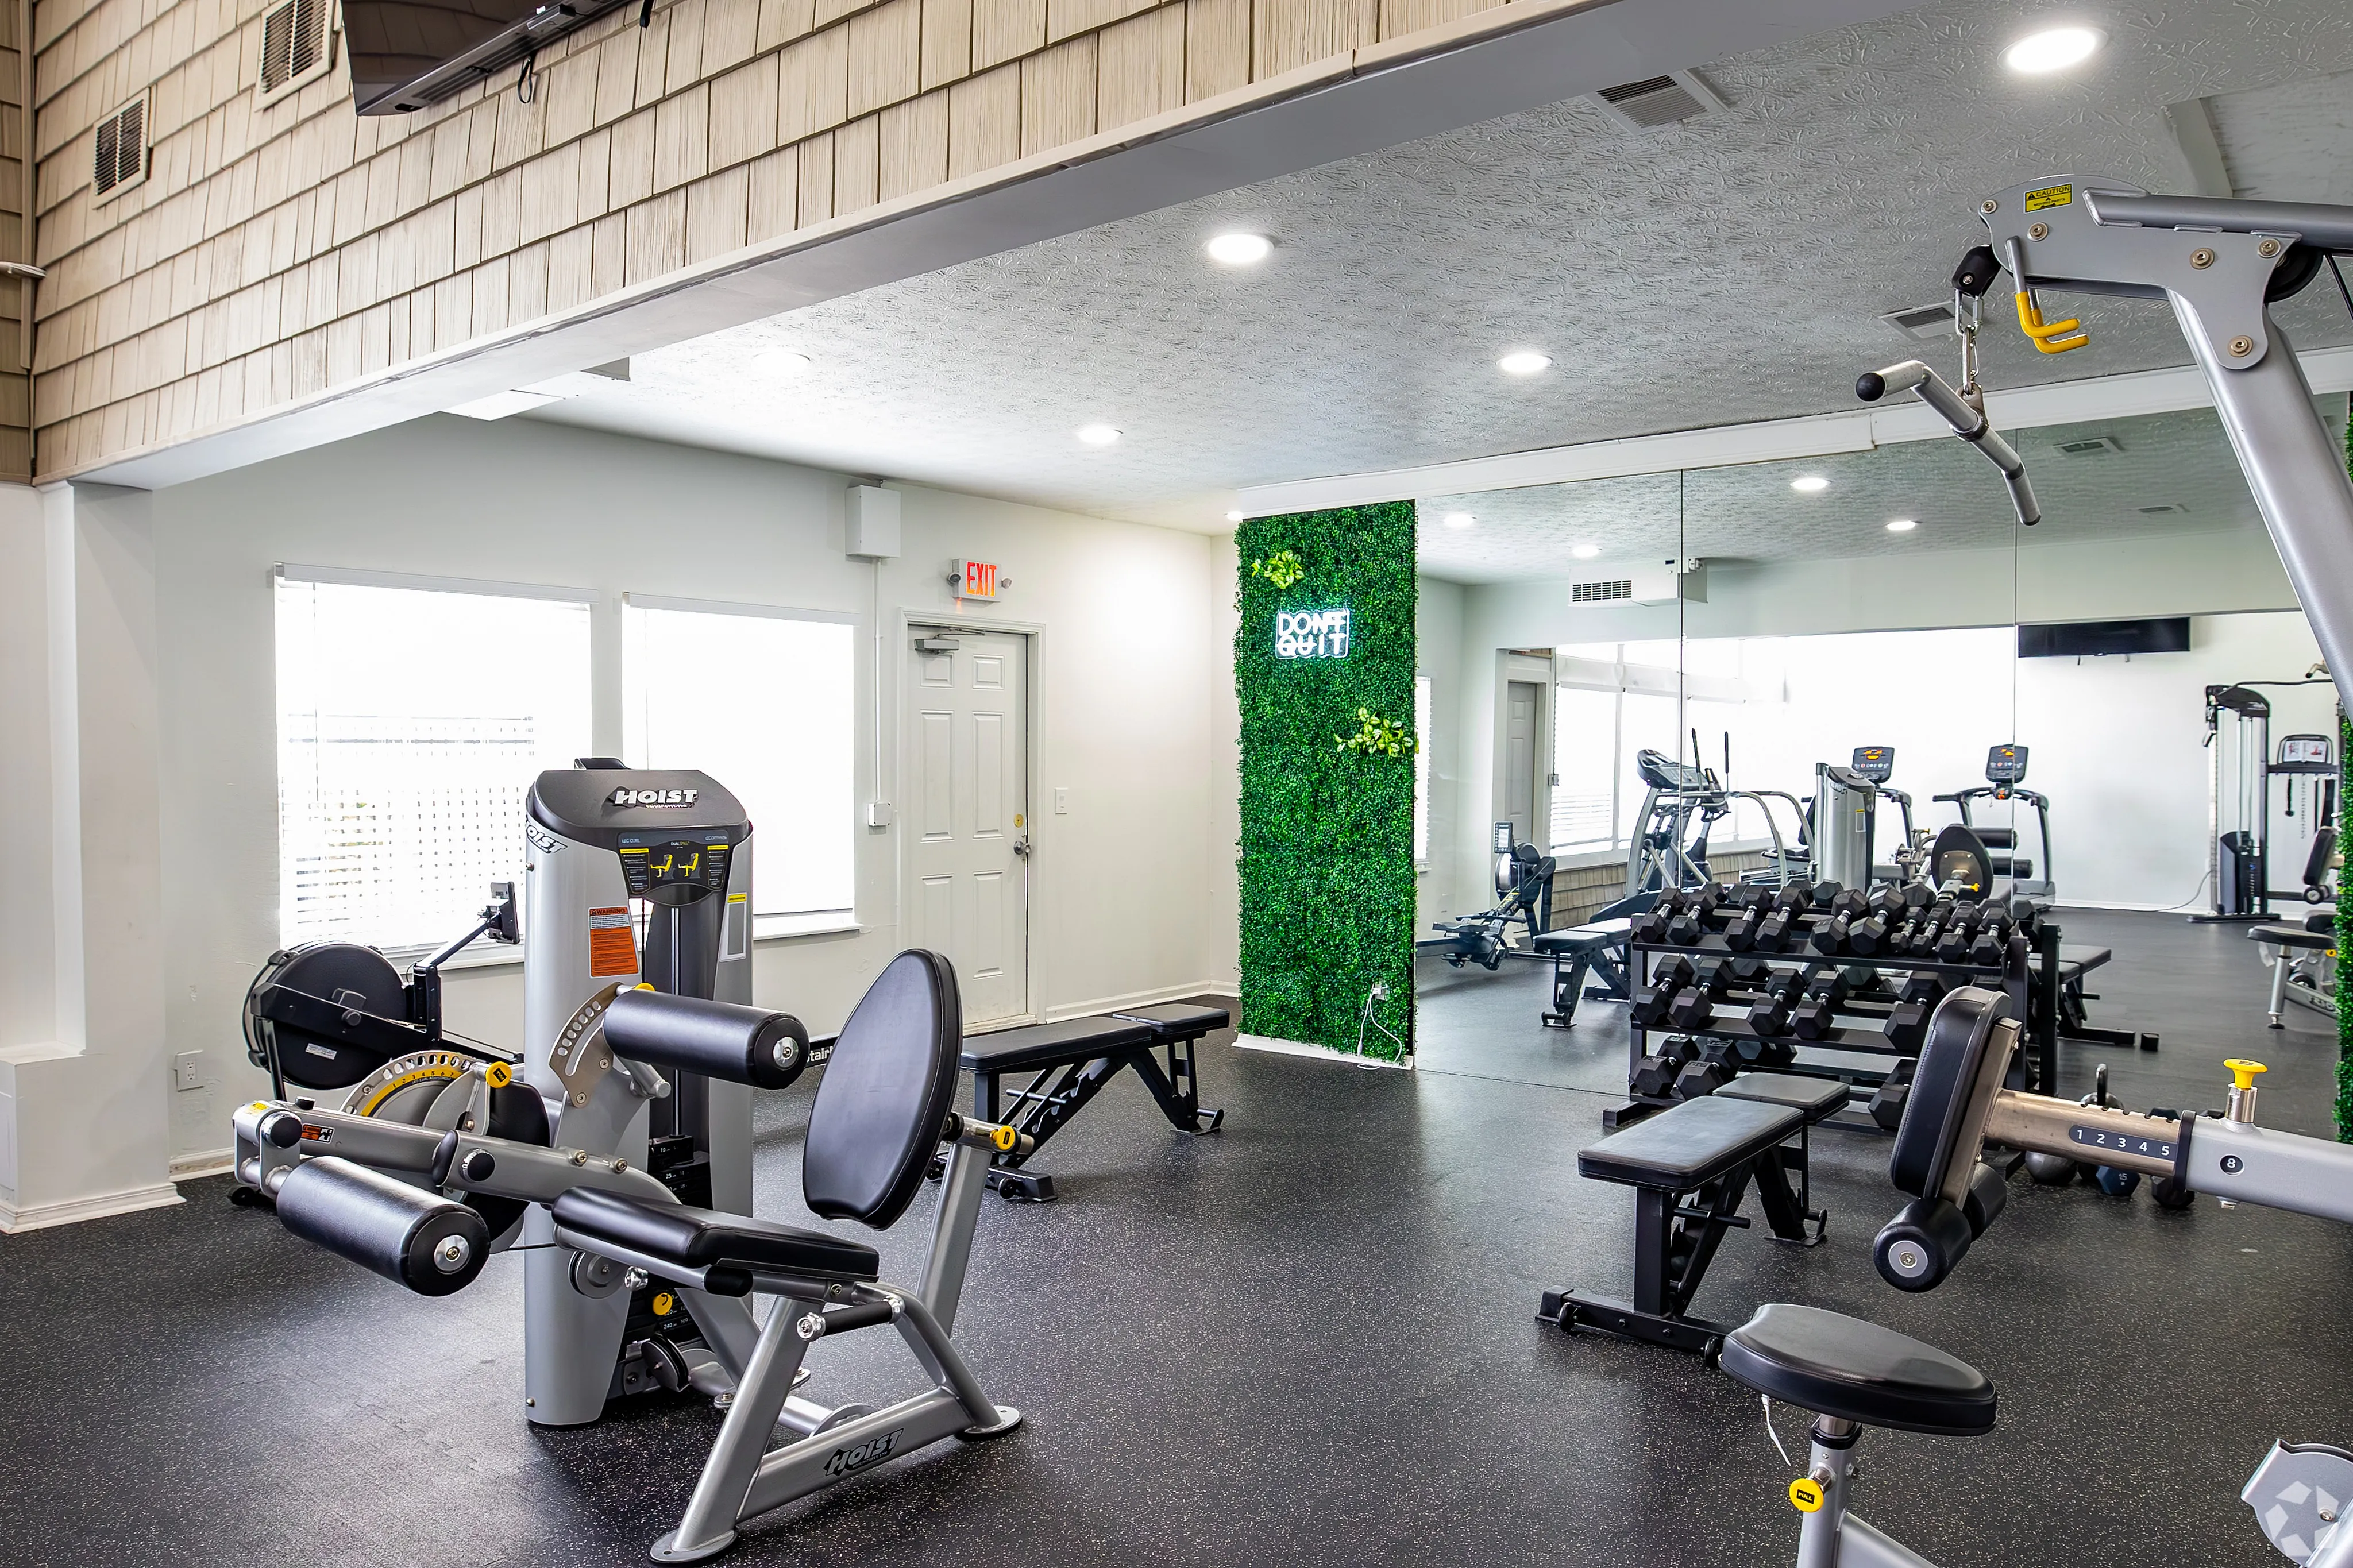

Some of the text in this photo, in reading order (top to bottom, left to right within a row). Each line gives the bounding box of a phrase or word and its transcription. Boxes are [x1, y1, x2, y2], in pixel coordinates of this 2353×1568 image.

[2036, 186, 2070, 196] CAUTION
[966, 562, 997, 597] EXIT
[1276, 632, 1347, 656] QUIT
[615, 789, 697, 804] HOIST
[807, 1046, 833, 1063] tair
[2077, 1130, 2169, 1156] 1 2 3 4 5
[2227, 1158, 2236, 1168] 8
[827, 1428, 904, 1476] HOIST
[1798, 1492, 1812, 1501] PULL
